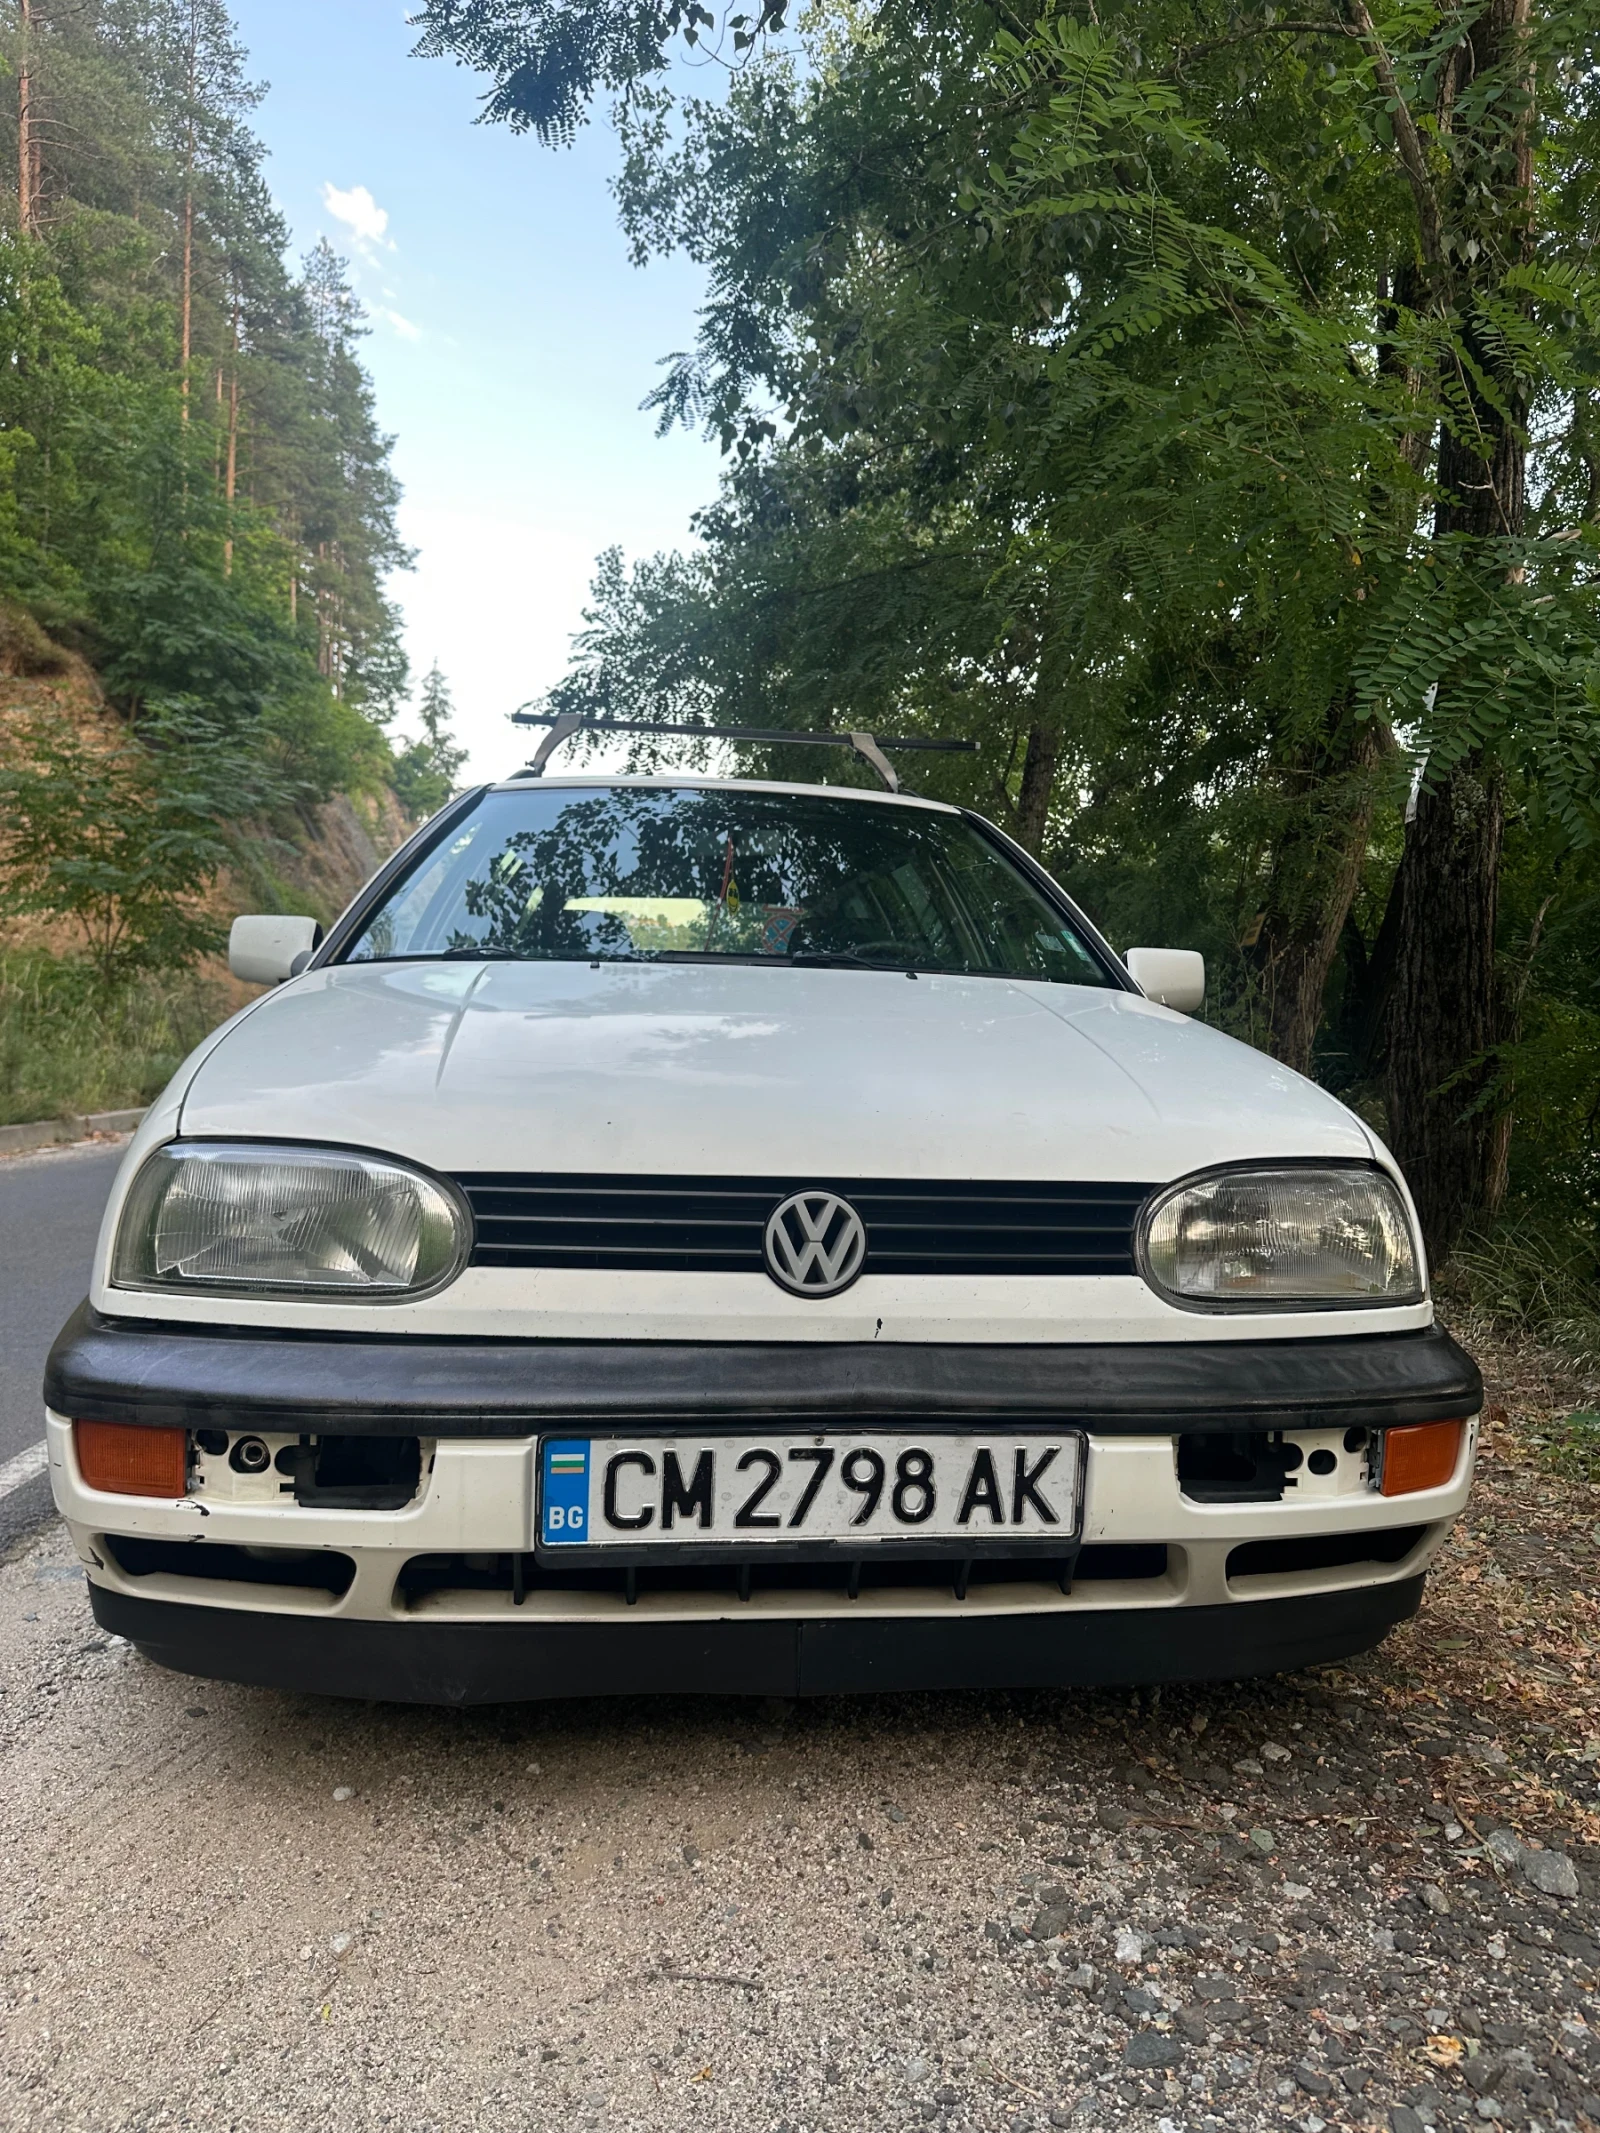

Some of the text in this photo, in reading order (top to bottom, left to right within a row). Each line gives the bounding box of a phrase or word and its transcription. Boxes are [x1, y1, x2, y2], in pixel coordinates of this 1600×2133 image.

[767, 1193, 865, 1292] VW
[548, 1506, 585, 1531] BG
[603, 1445, 1061, 1530] CM 2798 AK
